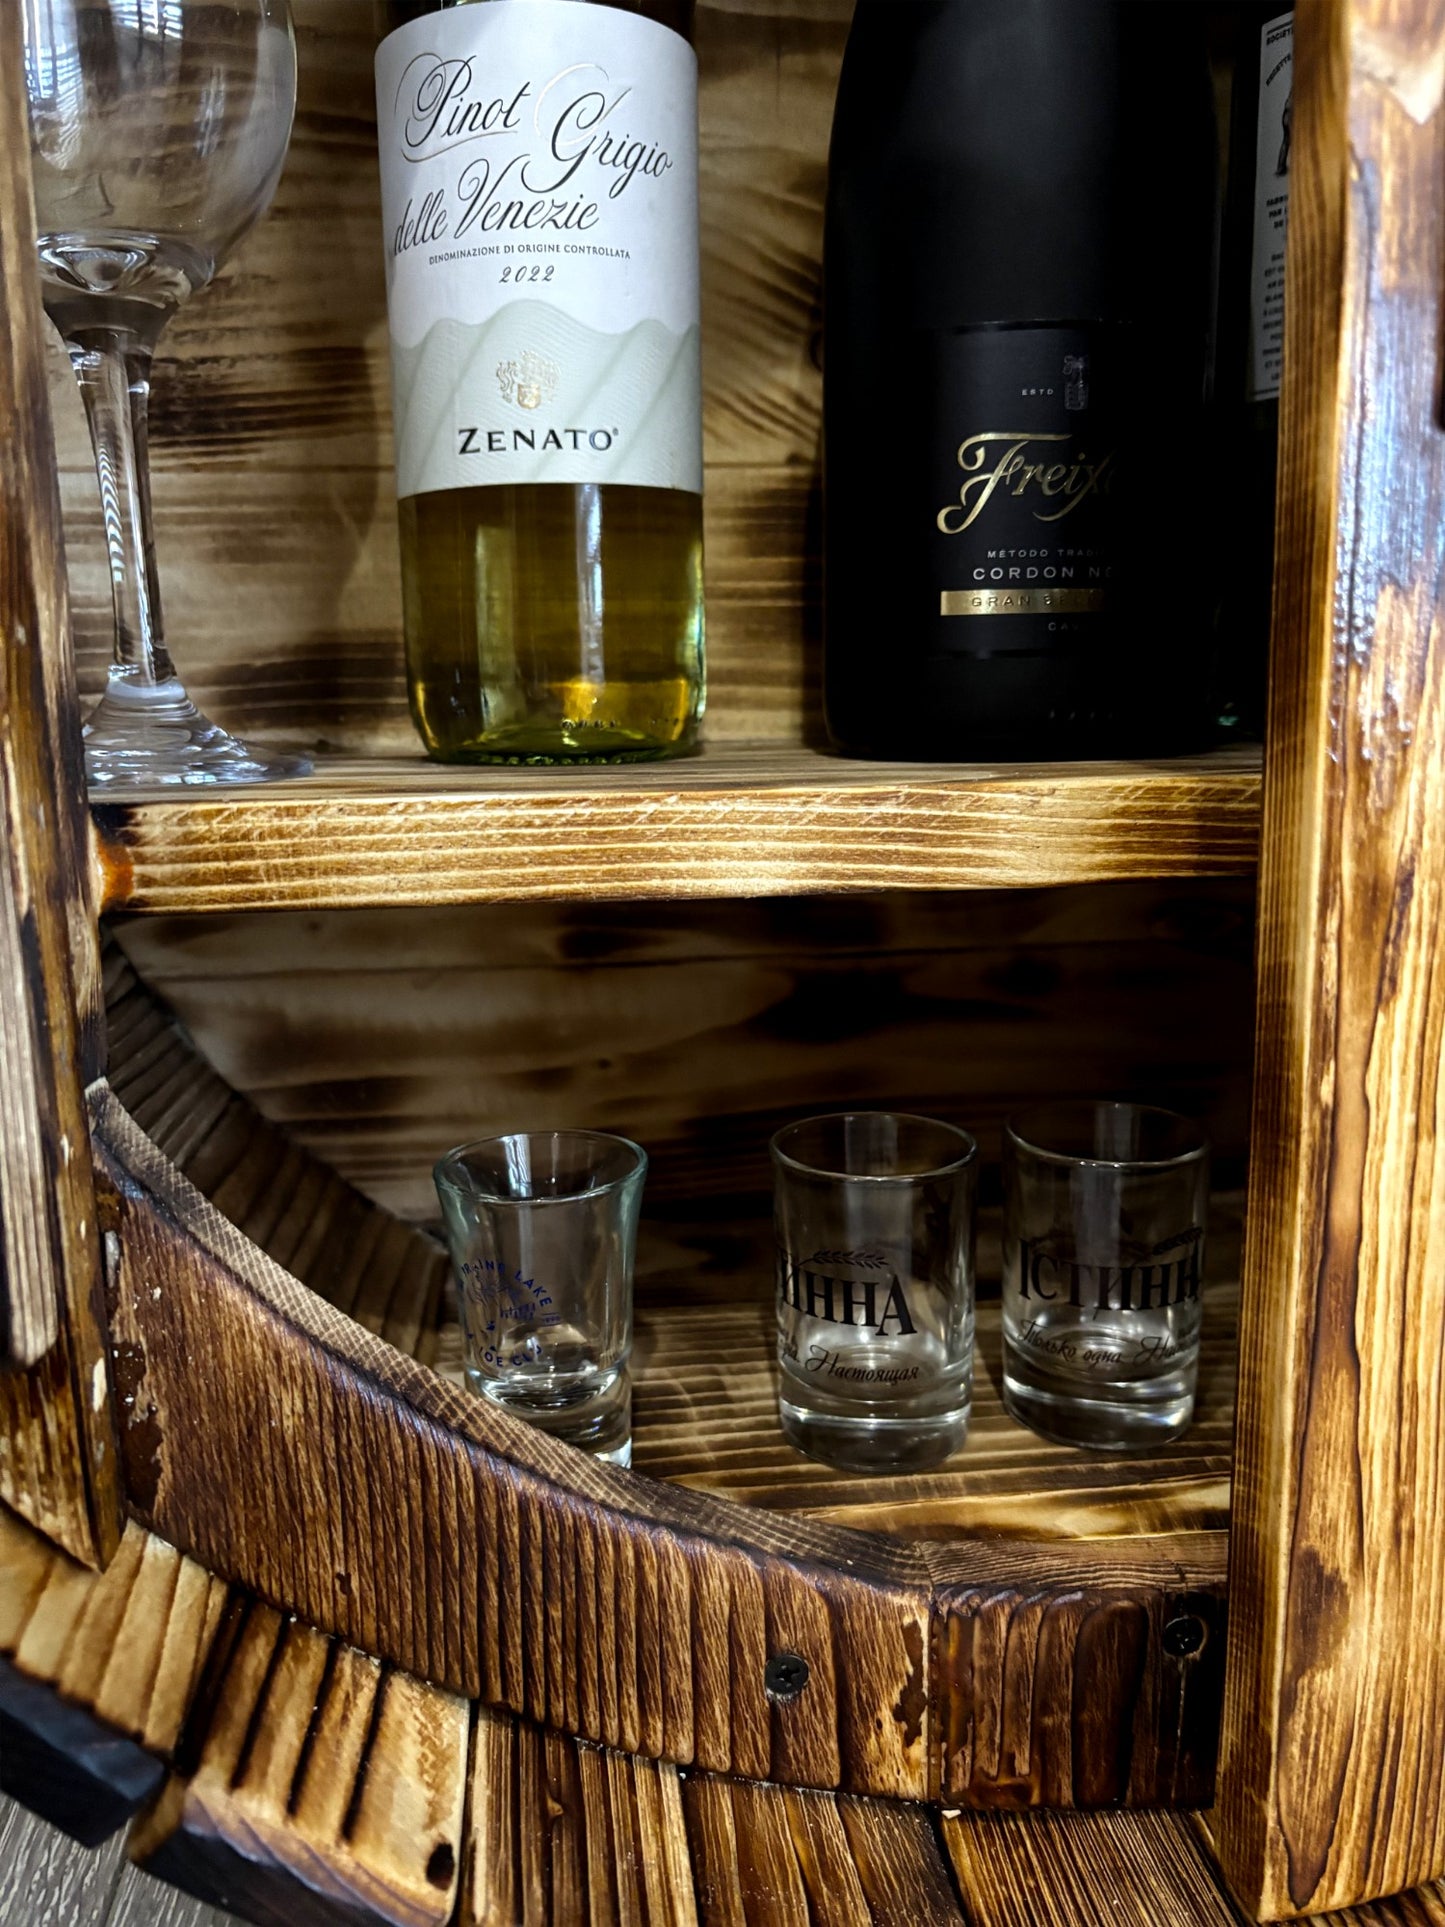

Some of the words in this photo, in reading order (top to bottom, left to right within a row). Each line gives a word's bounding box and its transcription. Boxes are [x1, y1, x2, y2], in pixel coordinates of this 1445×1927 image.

[395, 53, 531, 163] Pinot
[521, 87, 673, 199] Grigio
[393, 189, 447, 257] delle
[454, 153, 600, 239] Venezie
[429, 246, 501, 266] DENOMINAZIONE
[503, 244, 515, 255] DI
[517, 243, 561, 254] ORIGINE
[563, 244, 631, 261] CONTROLLATA
[498, 265, 556, 284] 2022
[972, 565, 1075, 581] CORDON
[971, 594, 1031, 608] GRAN
[514, 1269, 553, 1308] LAKE
[804, 1344, 920, 1386] Настоящая
